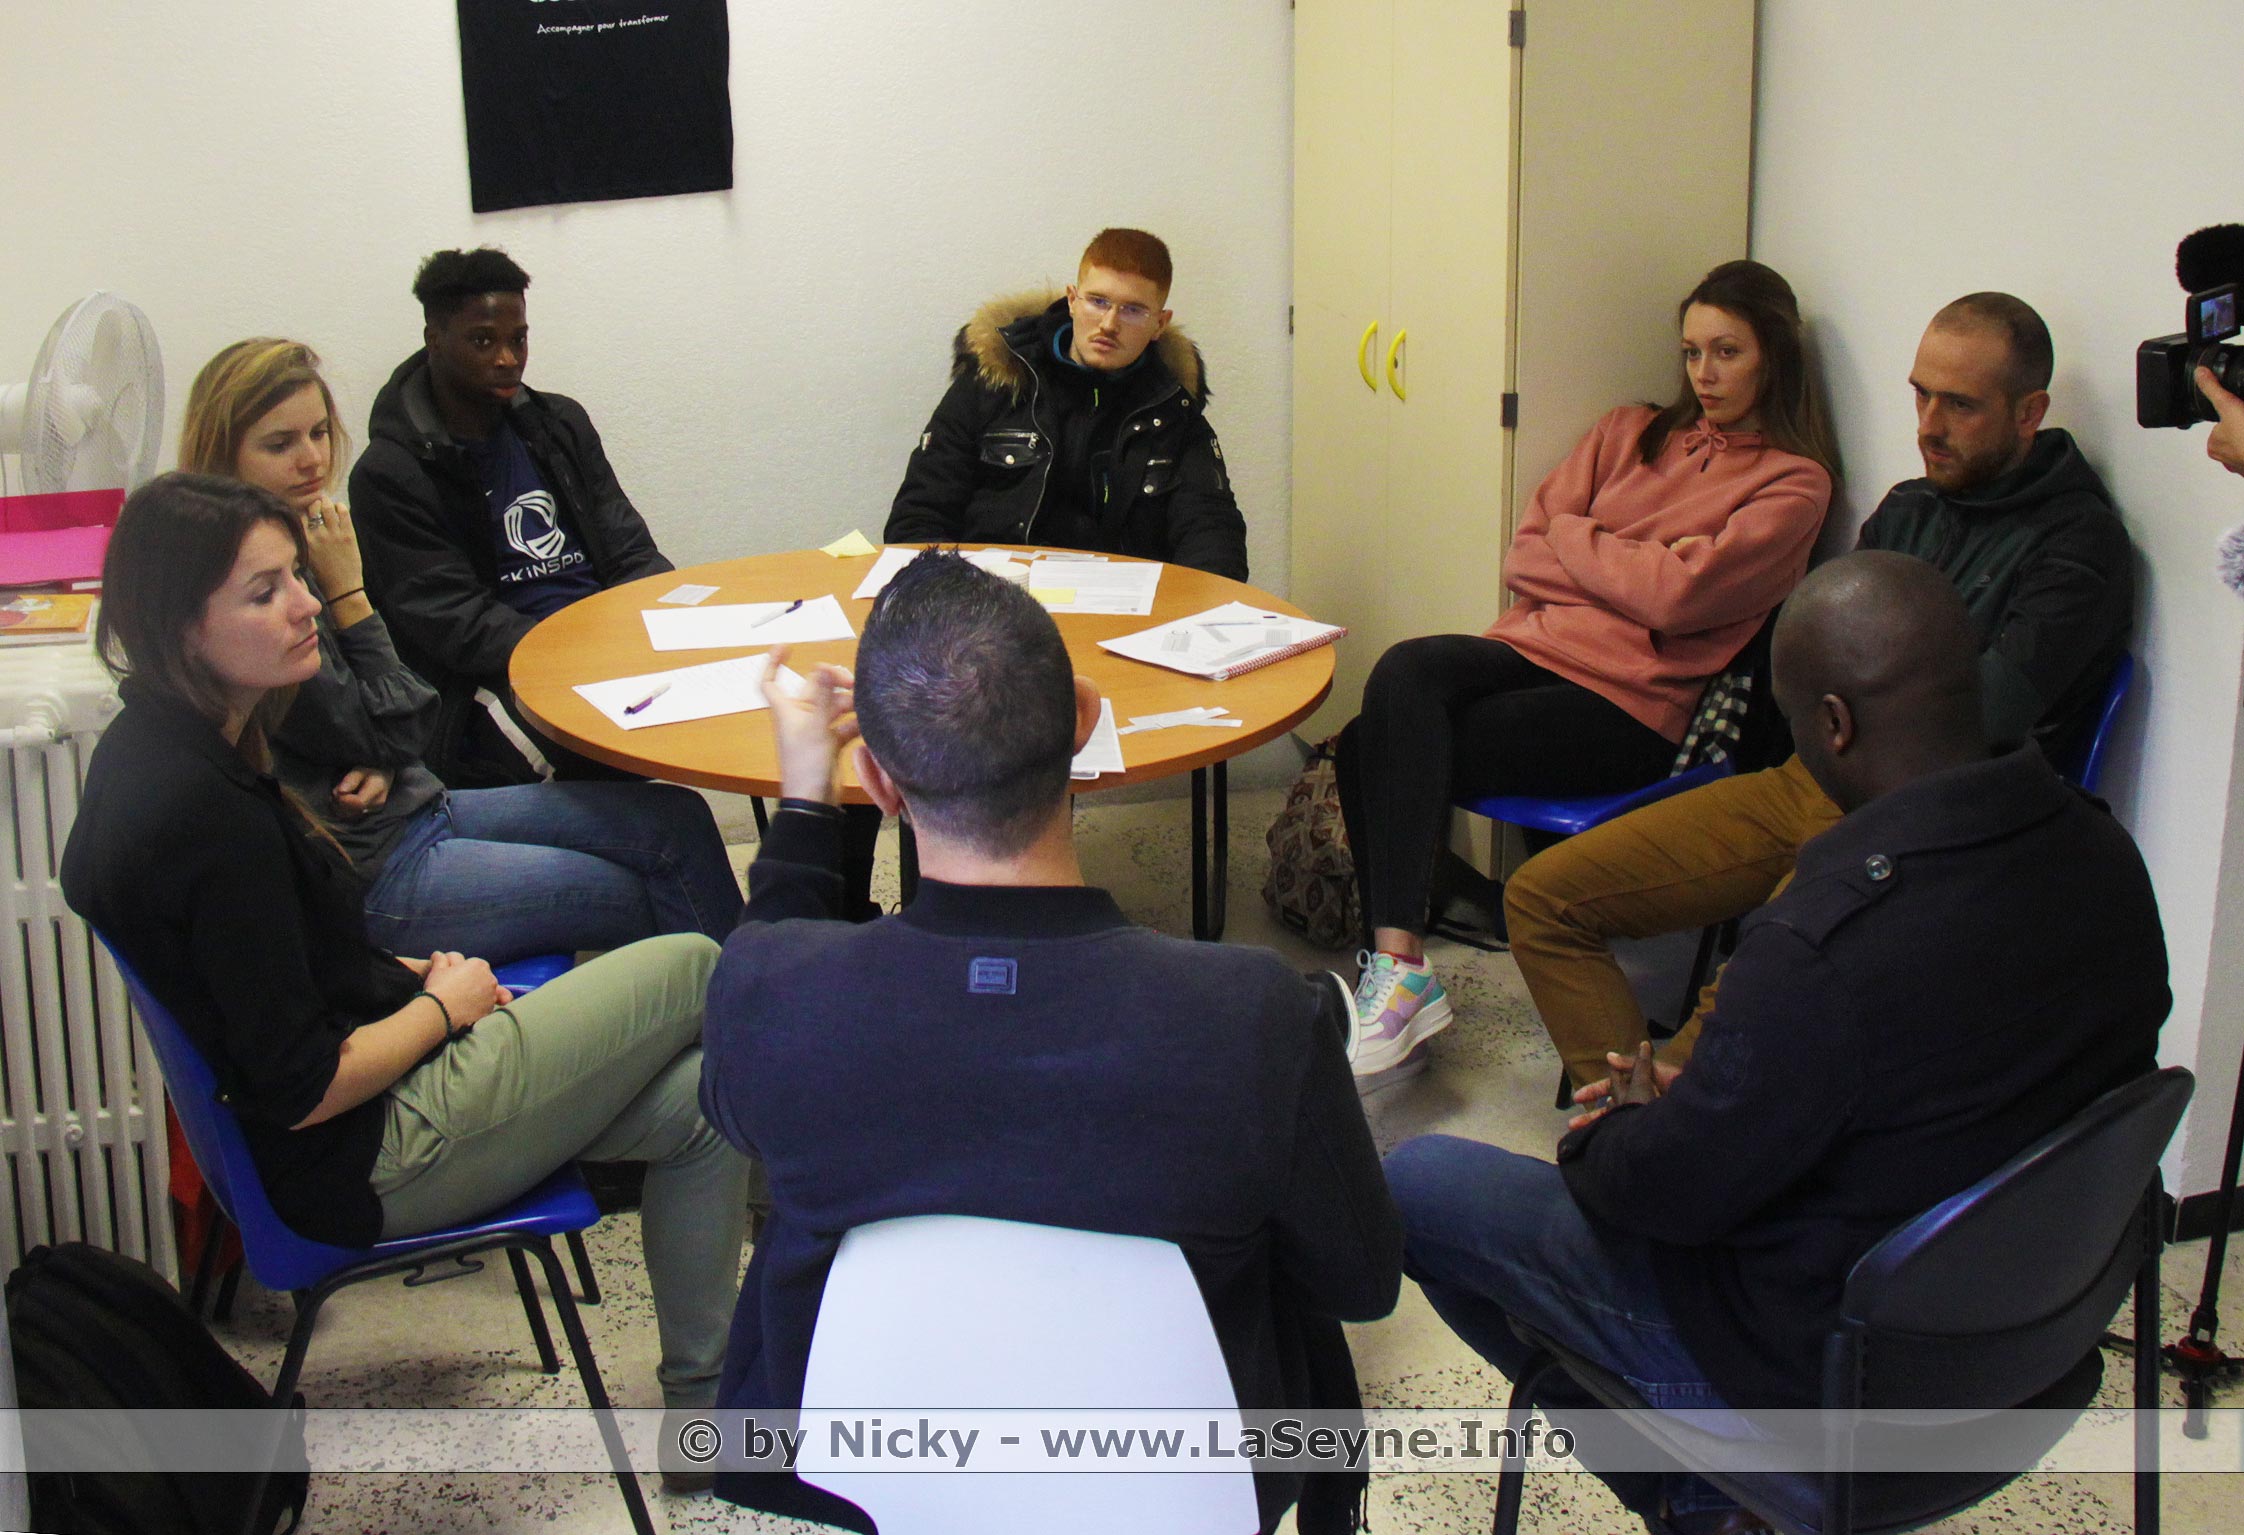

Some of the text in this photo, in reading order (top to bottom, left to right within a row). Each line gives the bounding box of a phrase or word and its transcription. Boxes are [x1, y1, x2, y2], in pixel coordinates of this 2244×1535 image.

[536, 14, 670, 35] Accompagner pour transformer
